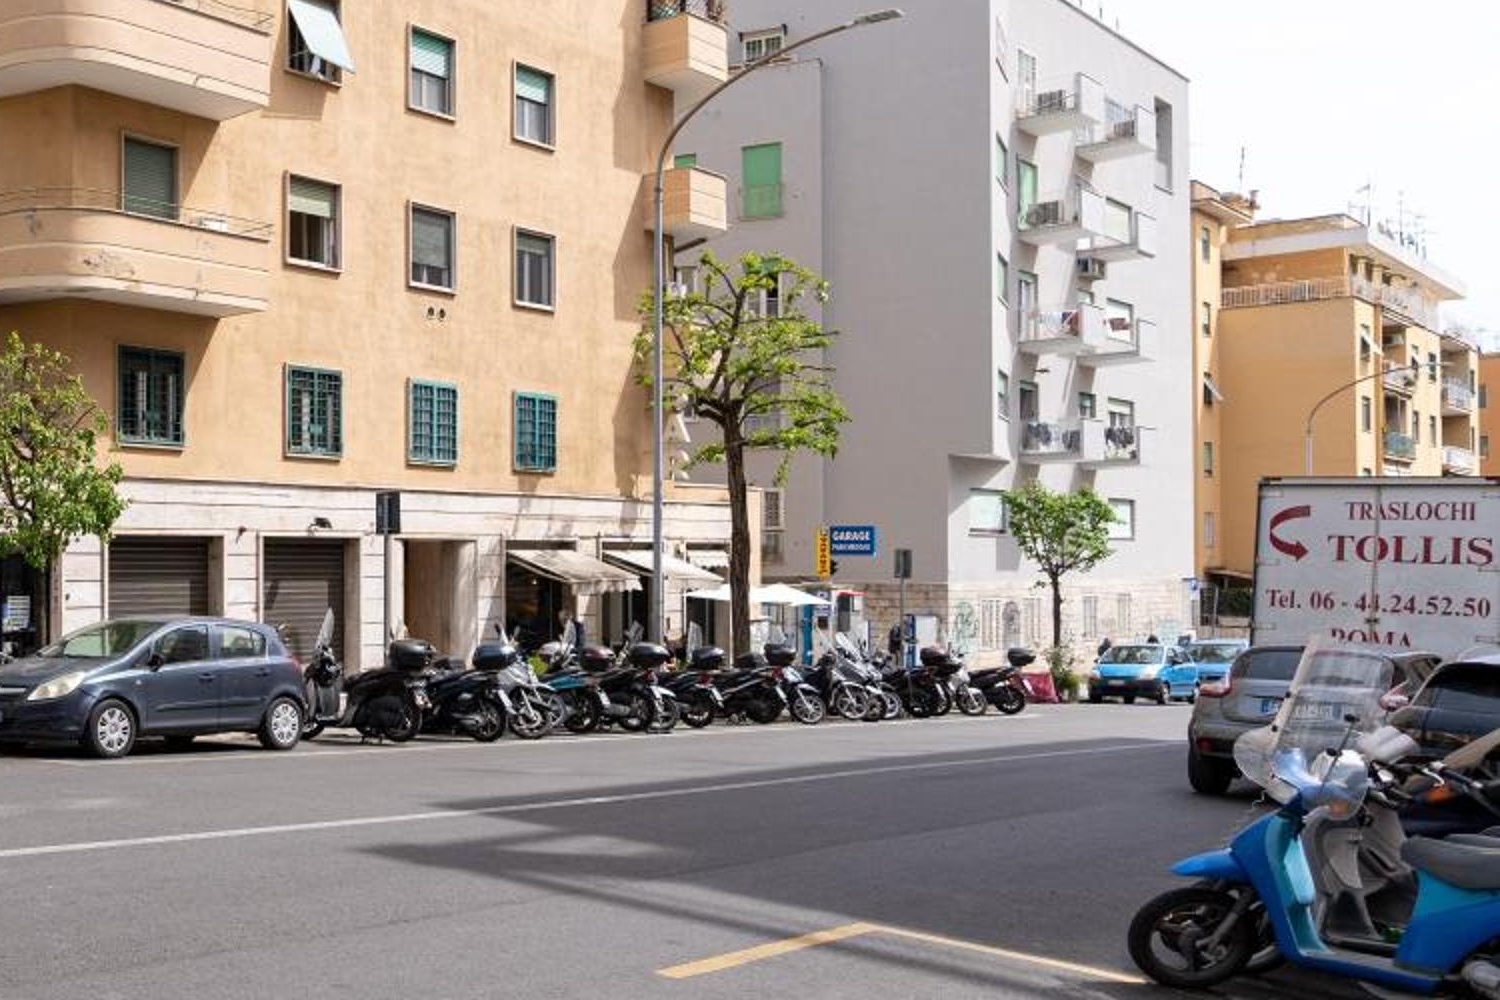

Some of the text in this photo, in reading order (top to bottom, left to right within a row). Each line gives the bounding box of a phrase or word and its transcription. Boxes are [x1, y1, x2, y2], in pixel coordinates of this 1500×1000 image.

[1346, 501, 1476, 521] TRASLOCHI
[831, 530, 871, 541] GARAGE
[1327, 535, 1494, 566] TOLLIS
[1266, 589, 1301, 609] Tel.
[1309, 590, 1335, 610] 06
